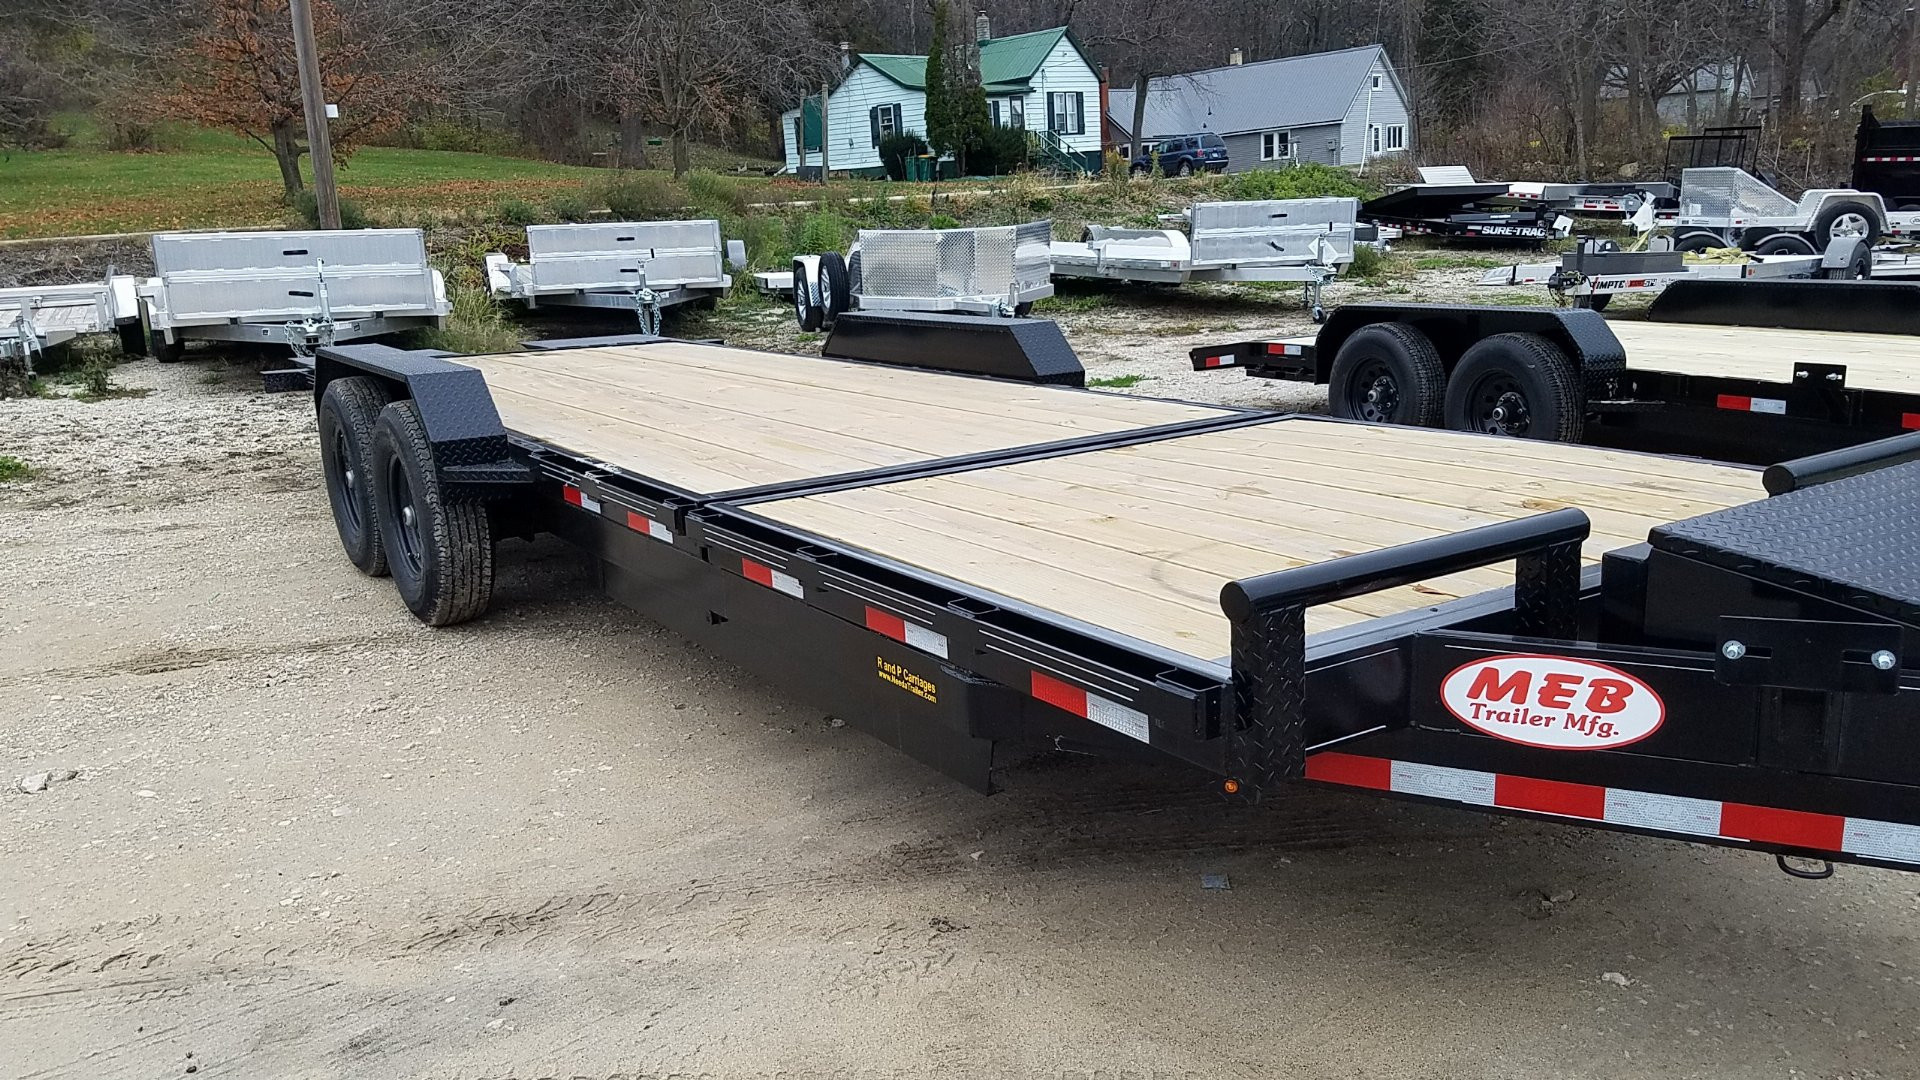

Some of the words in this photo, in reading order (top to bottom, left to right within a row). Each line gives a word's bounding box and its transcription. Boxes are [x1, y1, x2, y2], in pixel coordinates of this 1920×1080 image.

[1481, 225, 1547, 237] SURE-TRAC
[877, 656, 883, 669] R
[883, 661, 896, 675] and
[896, 665, 902, 677] P
[903, 668, 936, 694] Carriages
[1466, 666, 1634, 714] MEB
[1469, 702, 1556, 728] Trailer
[1564, 712, 1620, 738] Mfg.
